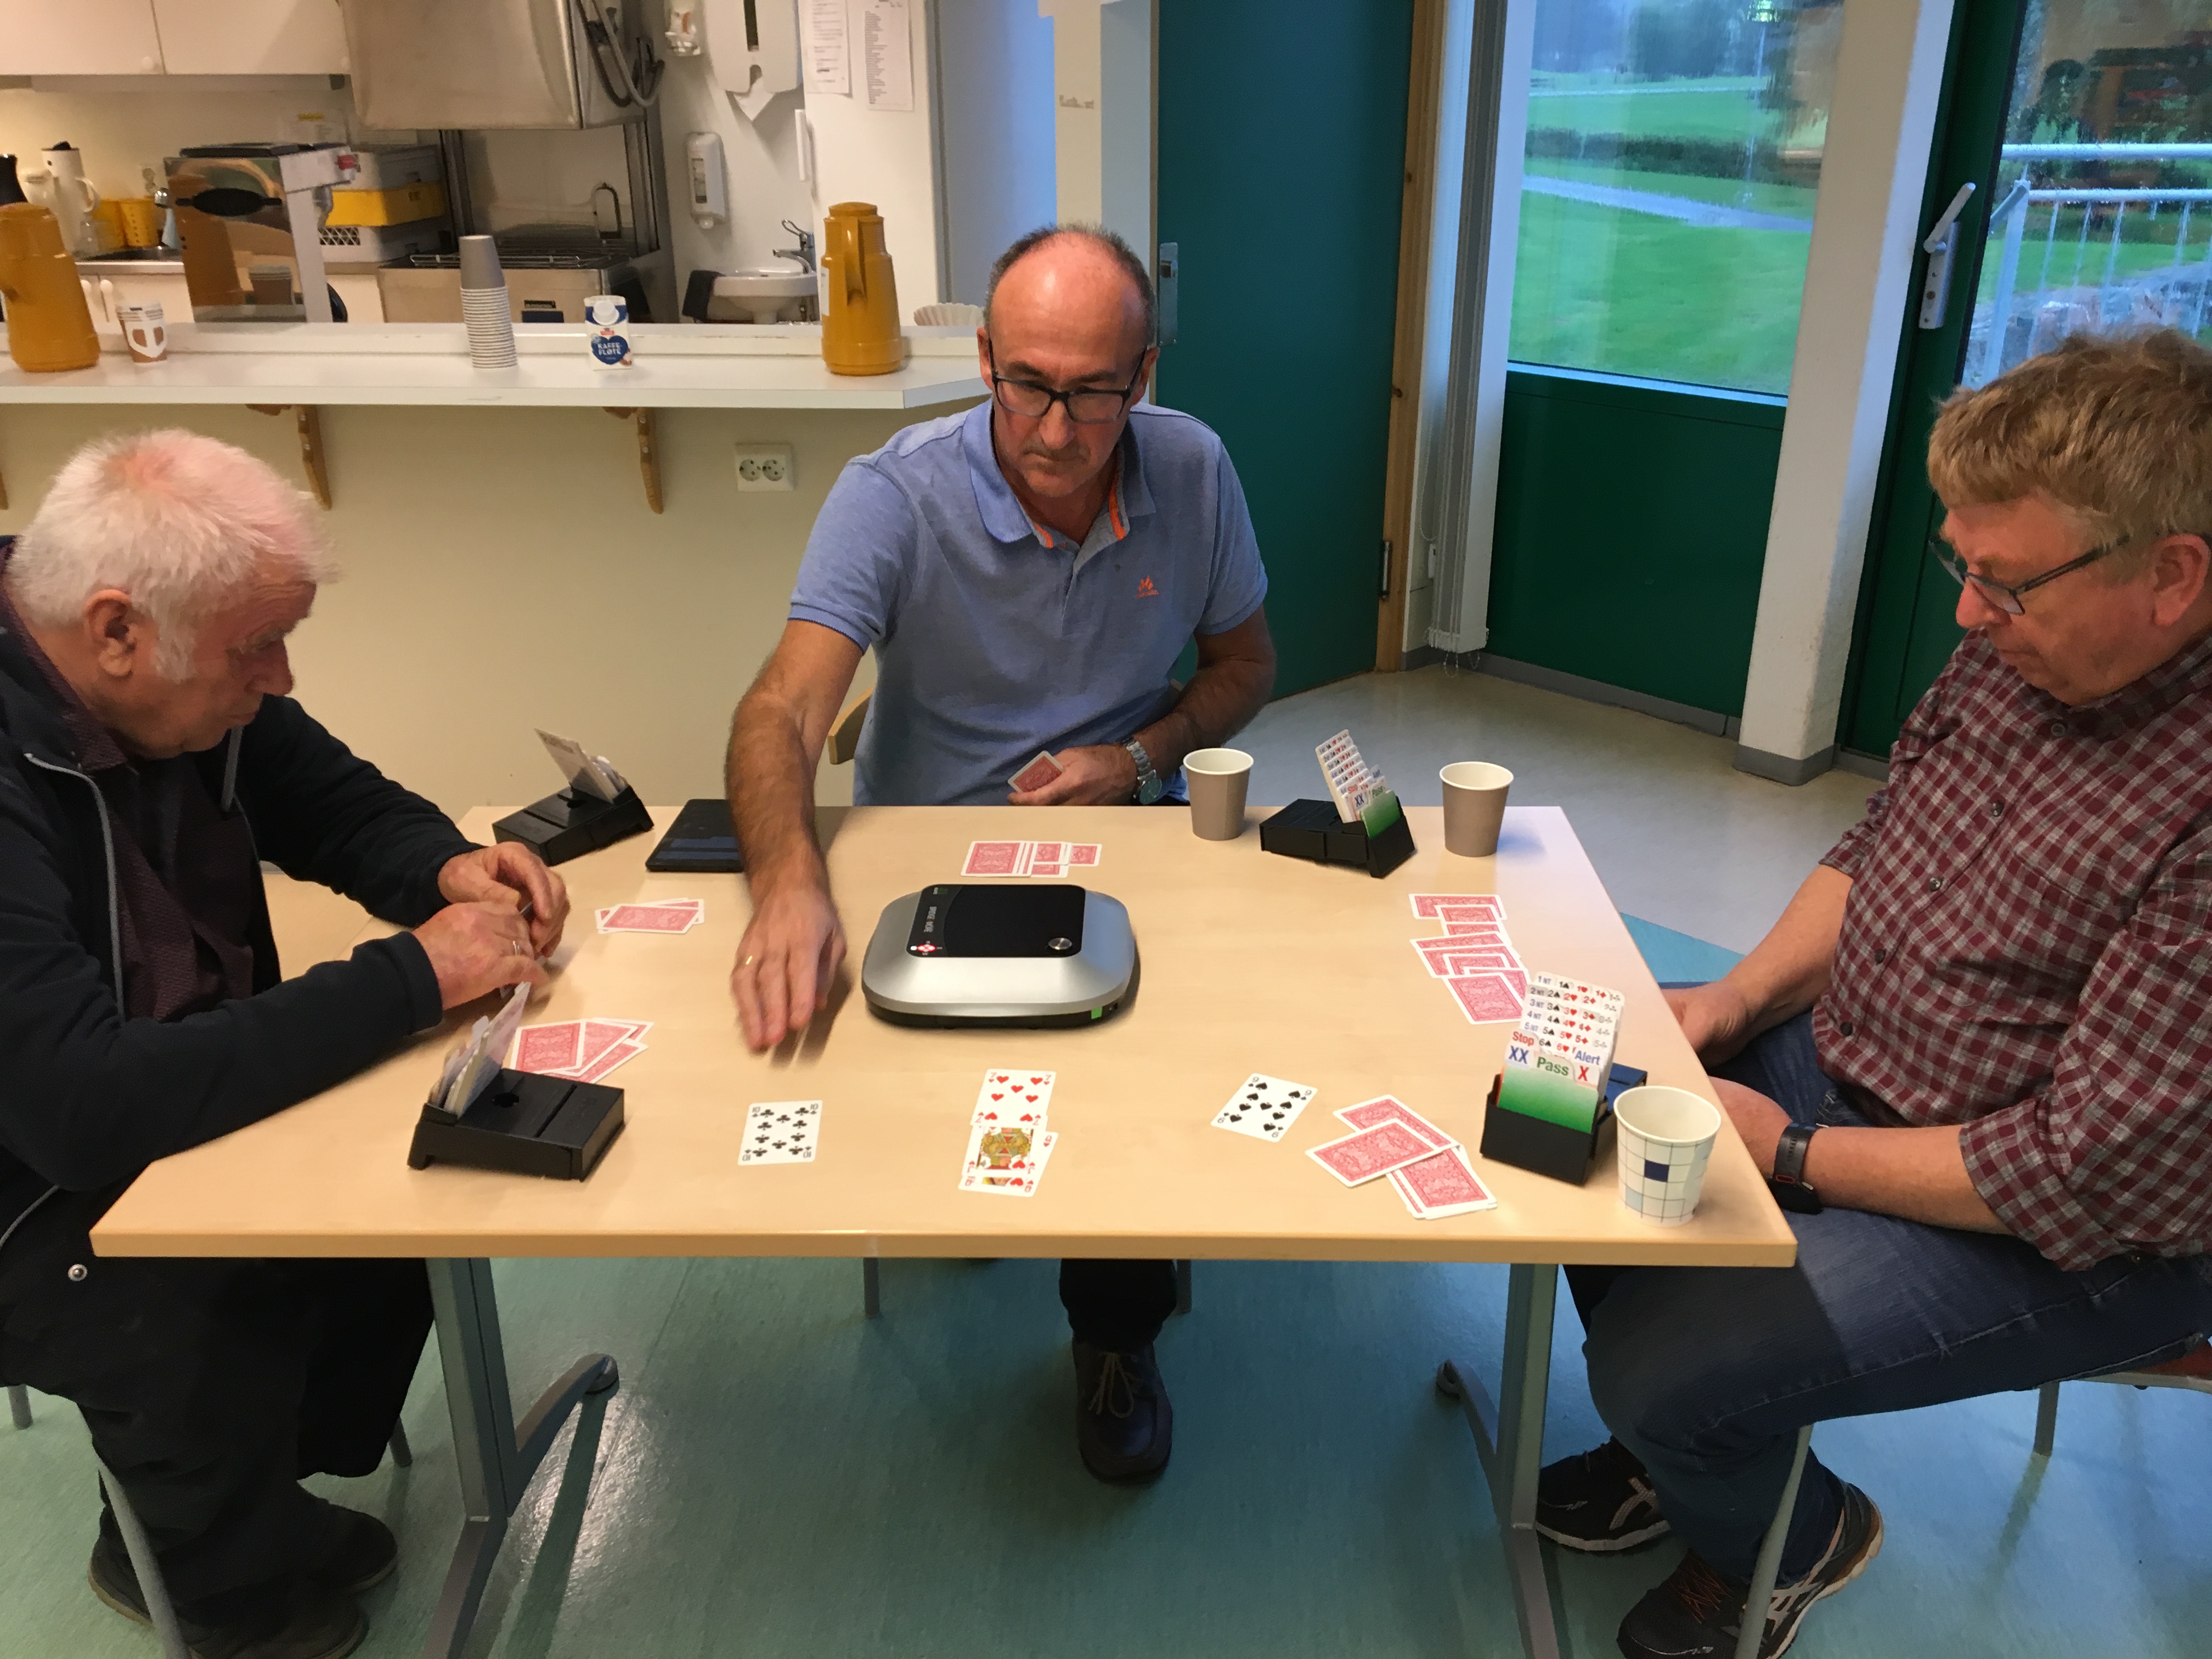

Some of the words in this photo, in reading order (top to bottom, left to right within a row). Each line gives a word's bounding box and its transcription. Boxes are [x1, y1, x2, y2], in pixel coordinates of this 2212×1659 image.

[1513, 1031, 1534, 1047] Stop
[1509, 1045, 1529, 1064] XX
[1575, 1050, 1601, 1065] Alert
[1537, 1057, 1569, 1076] Pass
[1578, 1065, 1589, 1082] X
